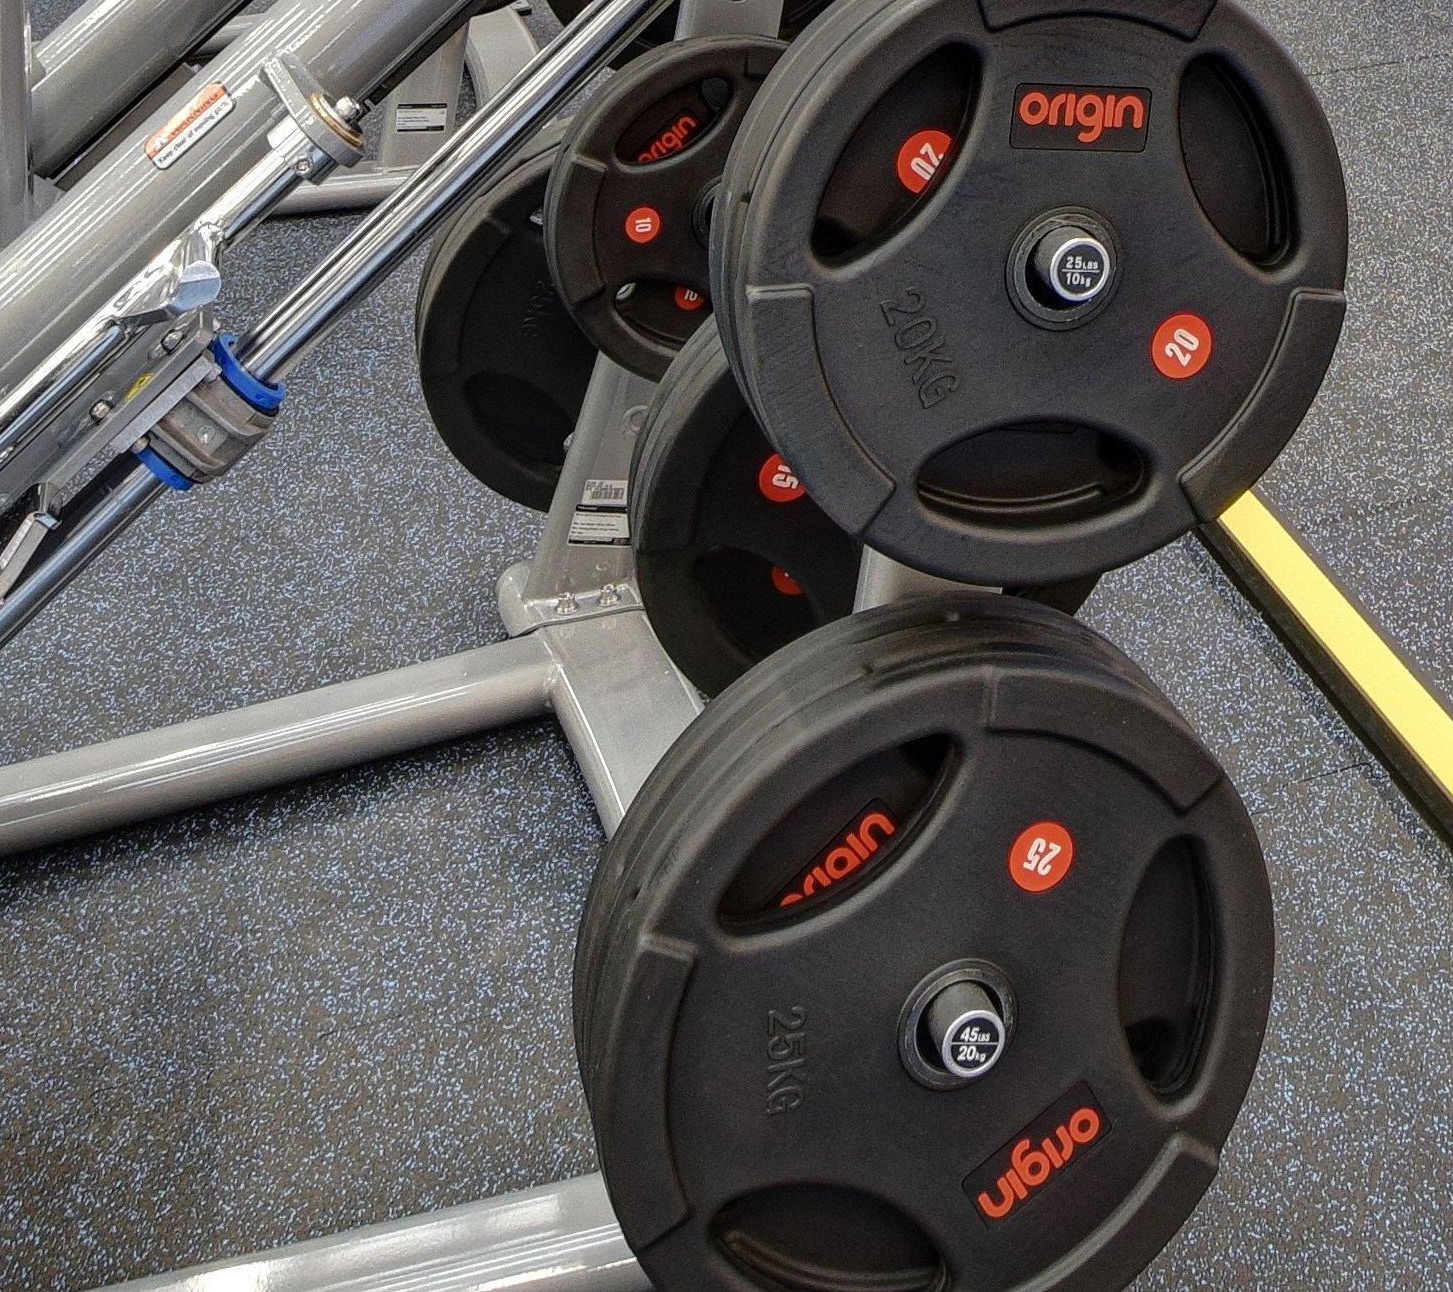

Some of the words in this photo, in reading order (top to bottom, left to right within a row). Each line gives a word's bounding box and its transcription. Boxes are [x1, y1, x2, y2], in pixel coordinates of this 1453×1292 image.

[1019, 92, 1144, 143] origin
[637, 117, 697, 162] origin
[635, 217, 653, 233] 10
[1065, 272, 1092, 287] 10kg
[1164, 328, 1200, 366] 20
[1023, 837, 1062, 876] 25
[957, 1045, 986, 1062] 20kg
[978, 1107, 1101, 1218] origin
